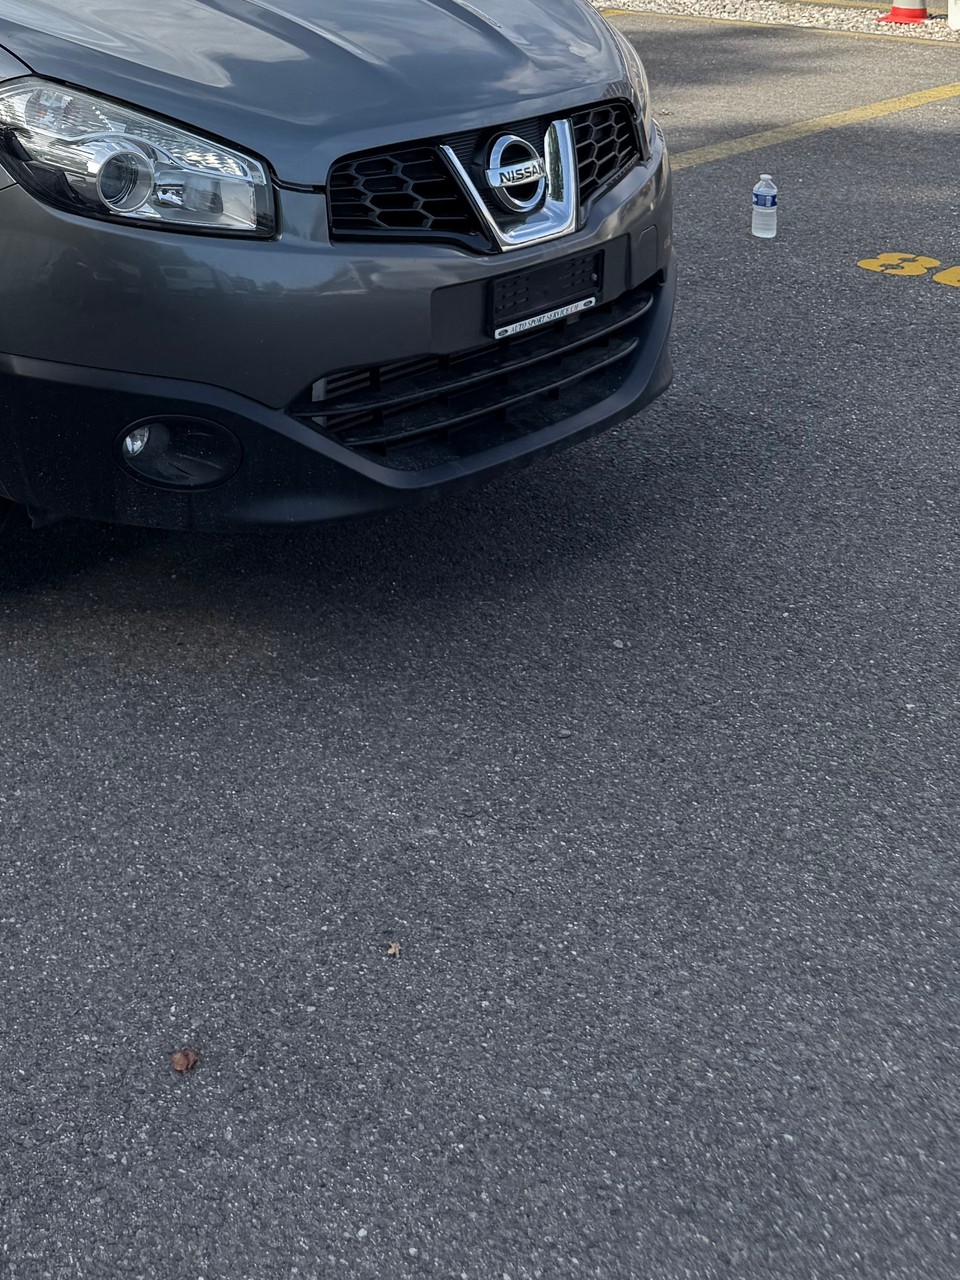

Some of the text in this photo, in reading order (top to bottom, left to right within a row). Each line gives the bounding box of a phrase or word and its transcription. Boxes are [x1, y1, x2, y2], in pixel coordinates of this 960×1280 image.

[499, 159, 546, 183] NISSAN
[510, 322, 527, 334] AUTO
[527, 315, 546, 327] SPORT
